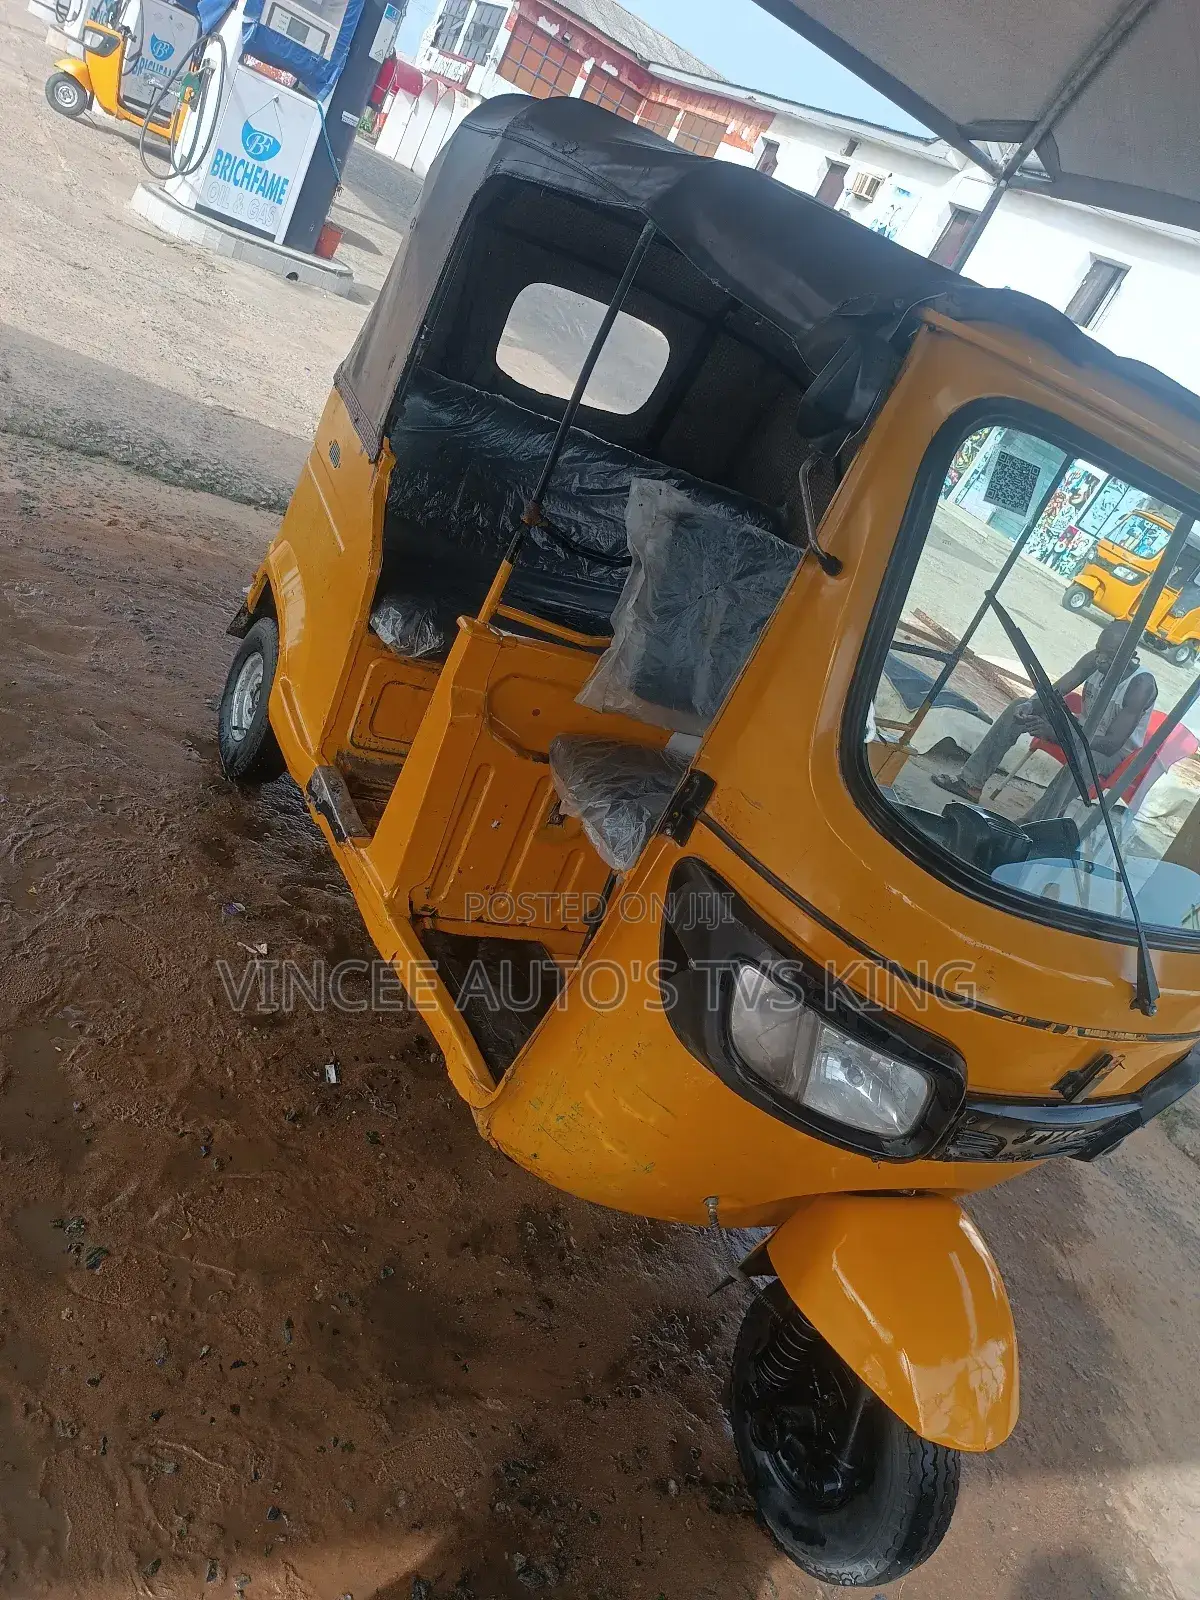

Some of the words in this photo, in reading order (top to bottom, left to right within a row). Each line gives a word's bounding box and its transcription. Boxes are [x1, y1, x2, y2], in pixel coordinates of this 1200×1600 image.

[210, 148, 289, 206] BRICHFAME
[207, 181, 231, 210] OIL
[232, 192, 245, 216] &
[247, 198, 278, 228] GAS
